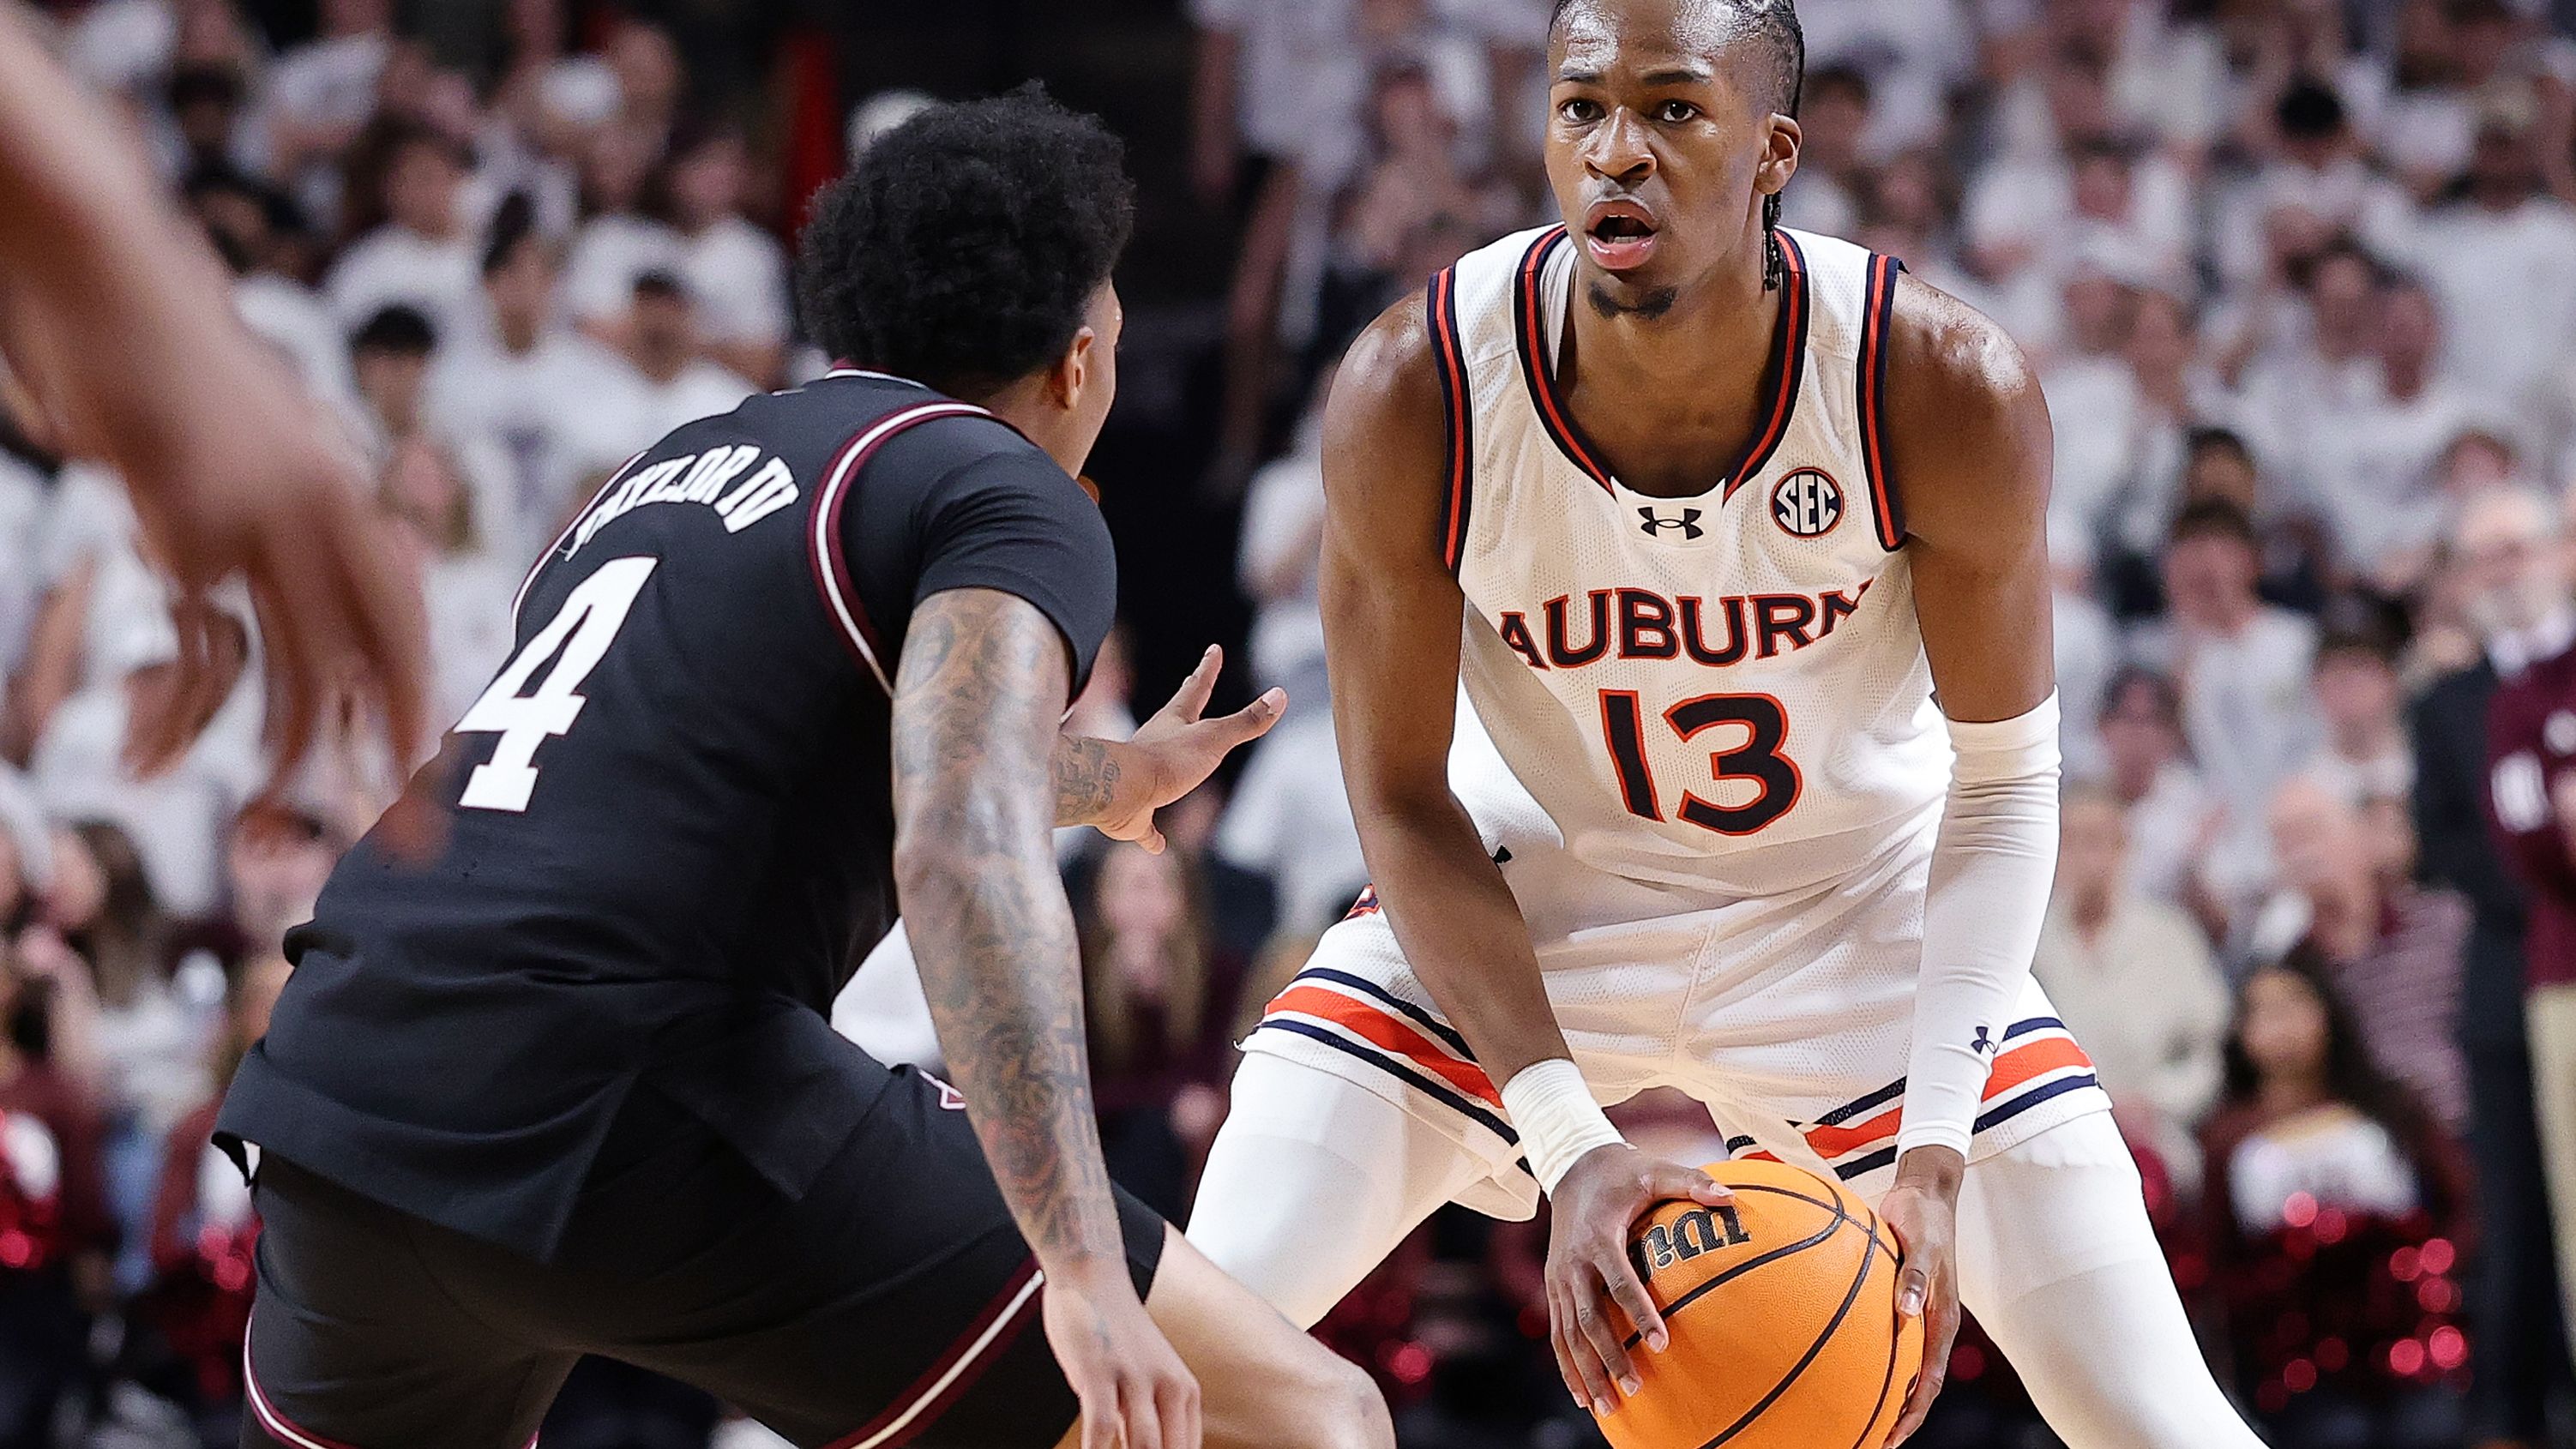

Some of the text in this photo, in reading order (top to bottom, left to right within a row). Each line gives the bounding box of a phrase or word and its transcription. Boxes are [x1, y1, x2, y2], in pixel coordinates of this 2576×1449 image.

[713, 455, 801, 534] IV
[1777, 473, 1837, 535] SEC
[453, 554, 658, 814] 4
[1598, 688, 1803, 836] 13
